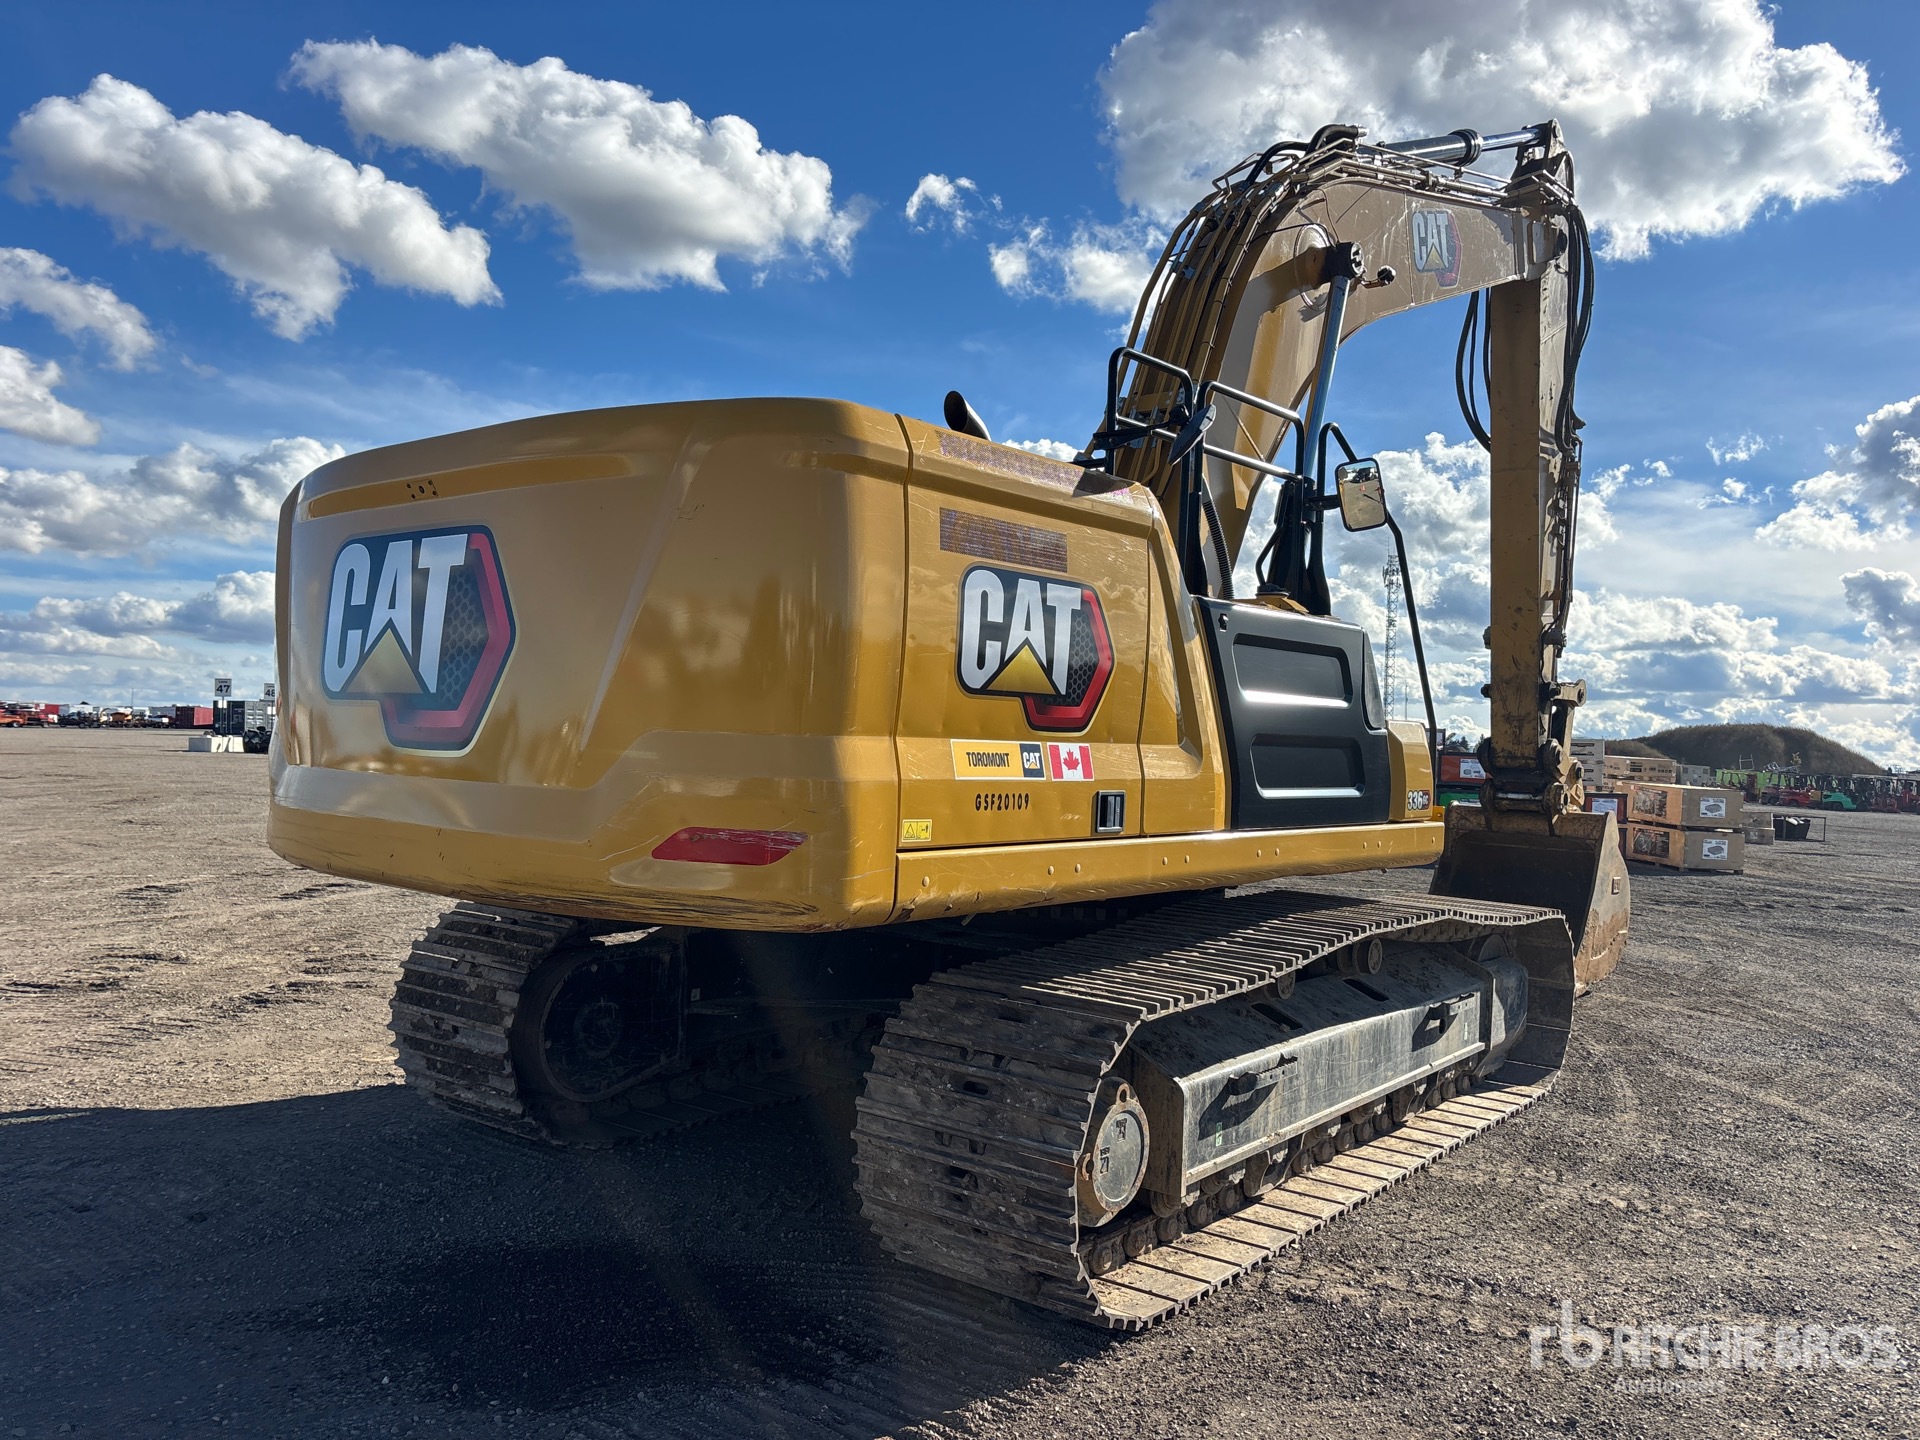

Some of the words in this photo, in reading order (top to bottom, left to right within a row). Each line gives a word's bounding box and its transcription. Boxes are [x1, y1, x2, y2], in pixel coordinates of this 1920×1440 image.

[1412, 212, 1449, 270] CAT
[324, 533, 468, 694] CAT
[960, 569, 1082, 695] CAT
[216, 684, 231, 694] 47
[966, 752, 1010, 768] TOROMONT
[1022, 752, 1041, 770] CAT
[975, 793, 1030, 812] GSF20109
[1407, 790, 1423, 811] 336
